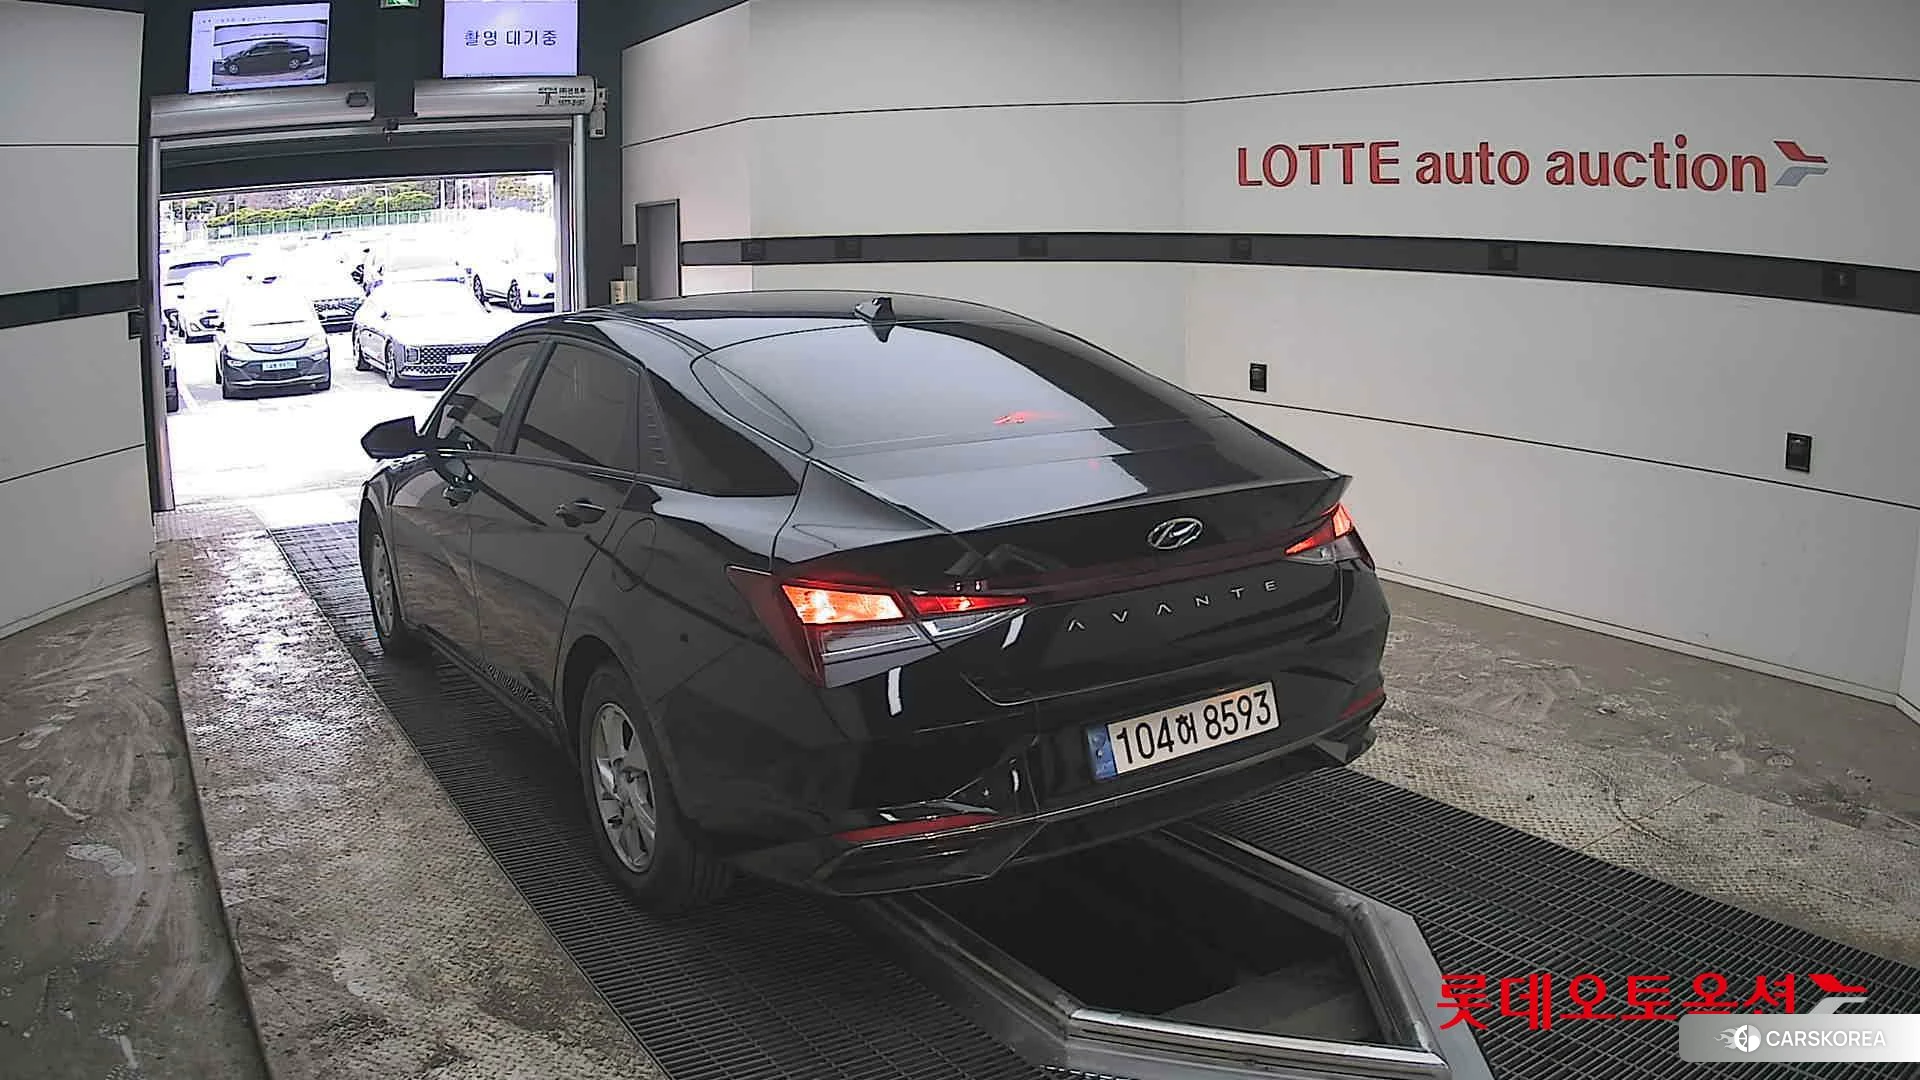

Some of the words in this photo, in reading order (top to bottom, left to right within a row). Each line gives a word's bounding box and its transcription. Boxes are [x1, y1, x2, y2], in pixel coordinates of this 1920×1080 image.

[505, 29, 558, 47] 대기중
[1237, 141, 1400, 187] LOTTE
[1416, 142, 1530, 186] auto
[1545, 134, 1767, 193] auction
[1067, 580, 1279, 632] AVANTE
[1116, 711, 1198, 764] 104허
[1203, 689, 1271, 740] 8593
